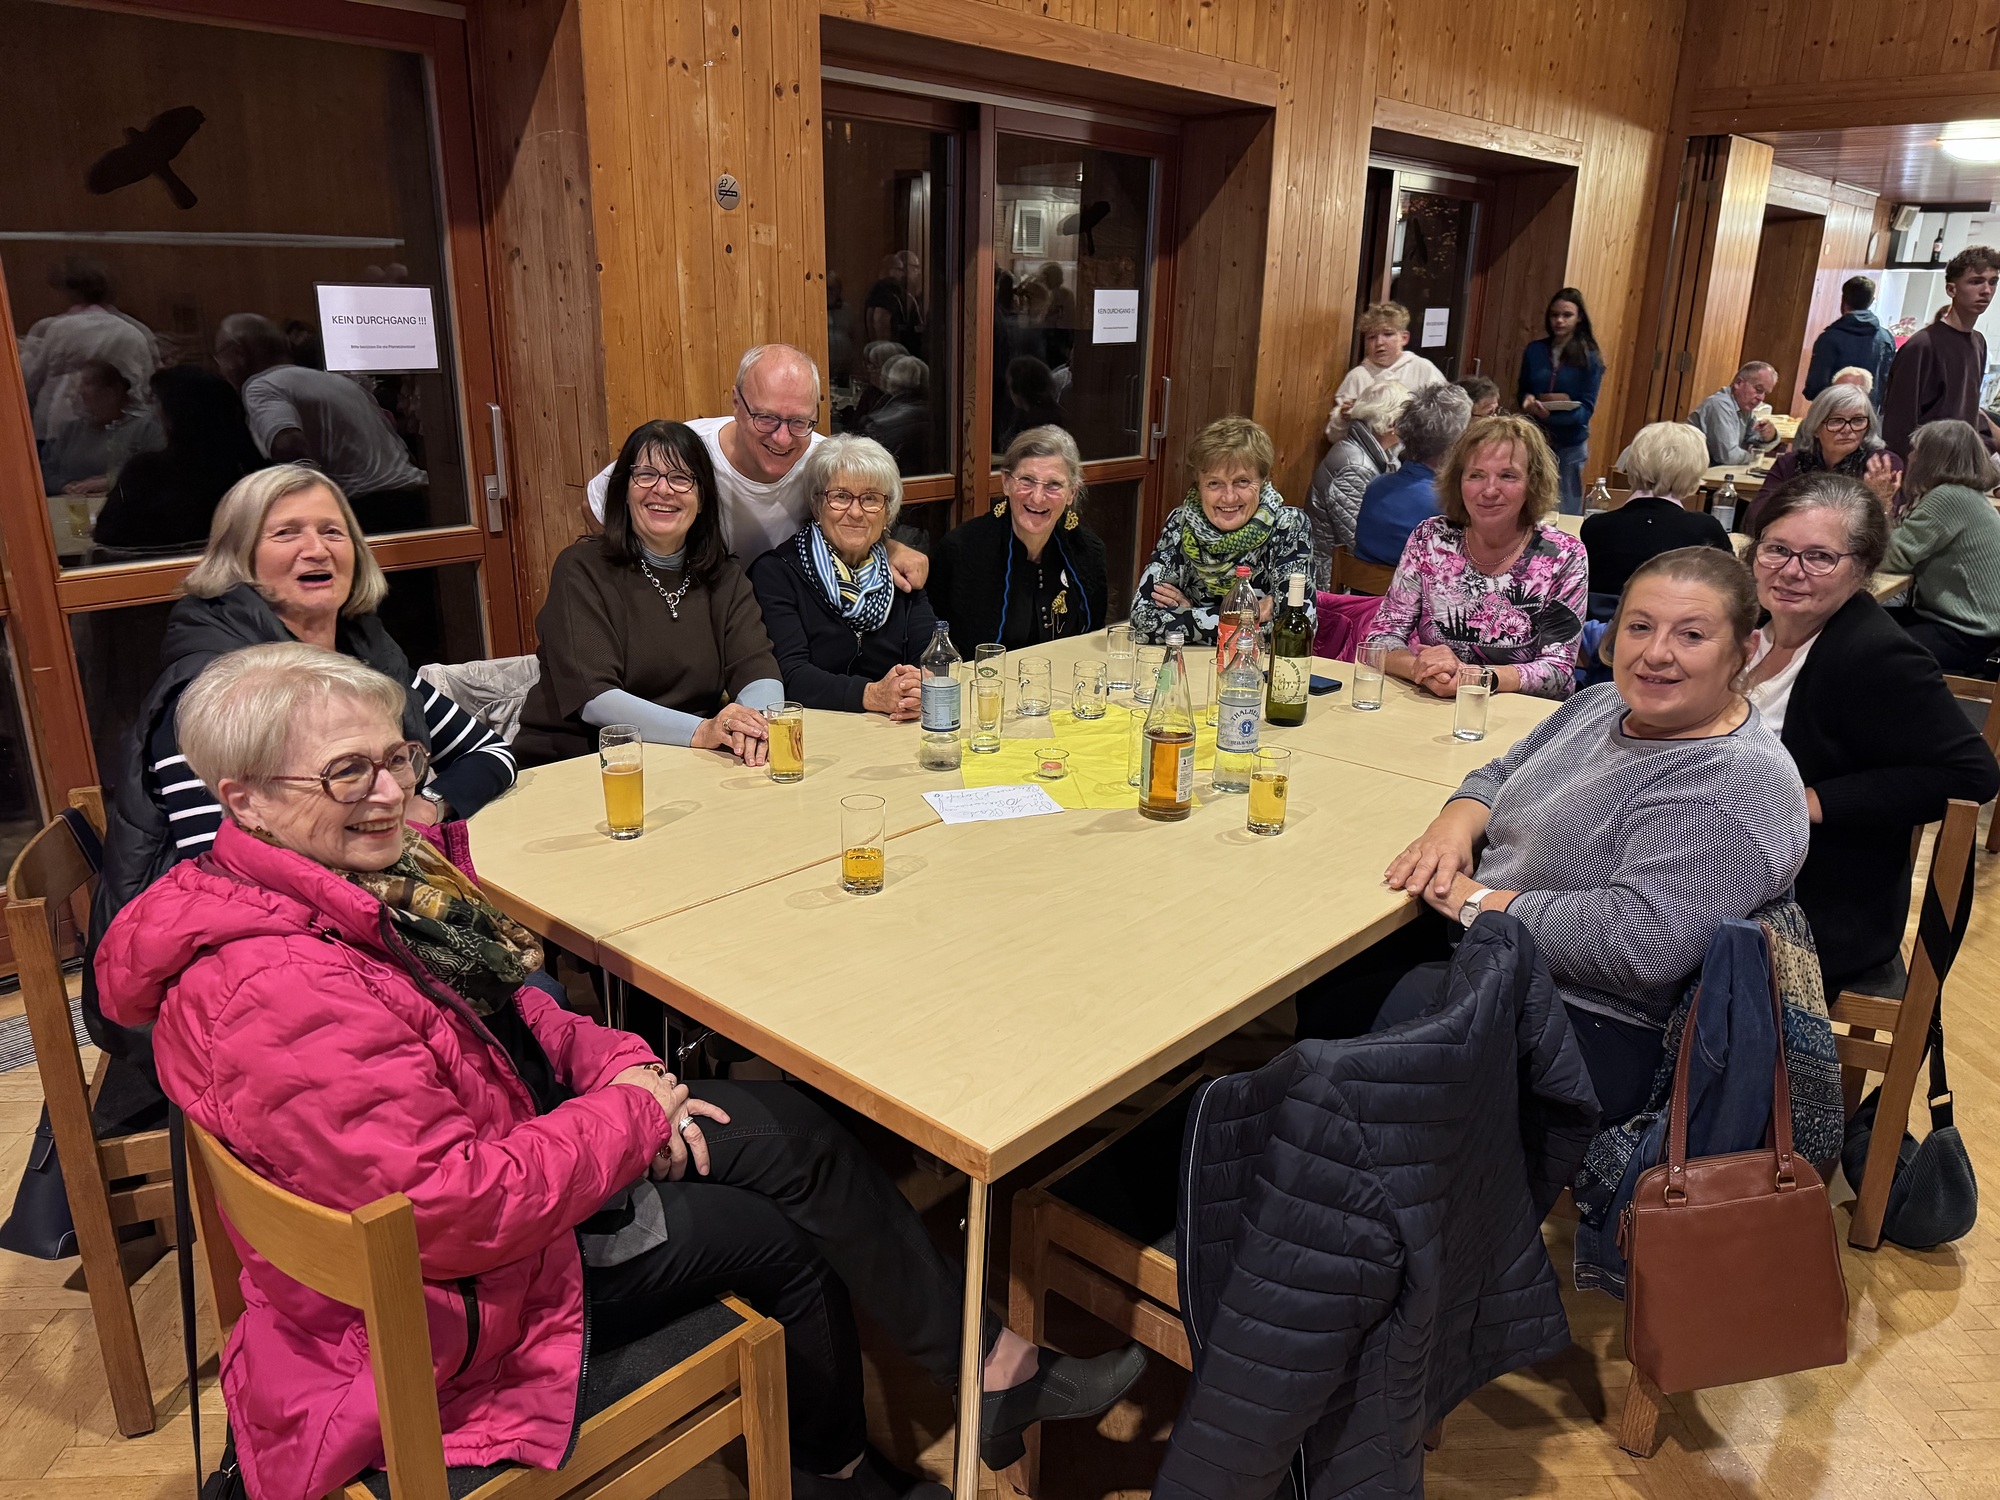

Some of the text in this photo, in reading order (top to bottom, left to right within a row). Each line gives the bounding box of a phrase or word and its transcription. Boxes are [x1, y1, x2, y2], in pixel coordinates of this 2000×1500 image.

[332, 315, 427, 326] KEIN DURCHGANG !!!
